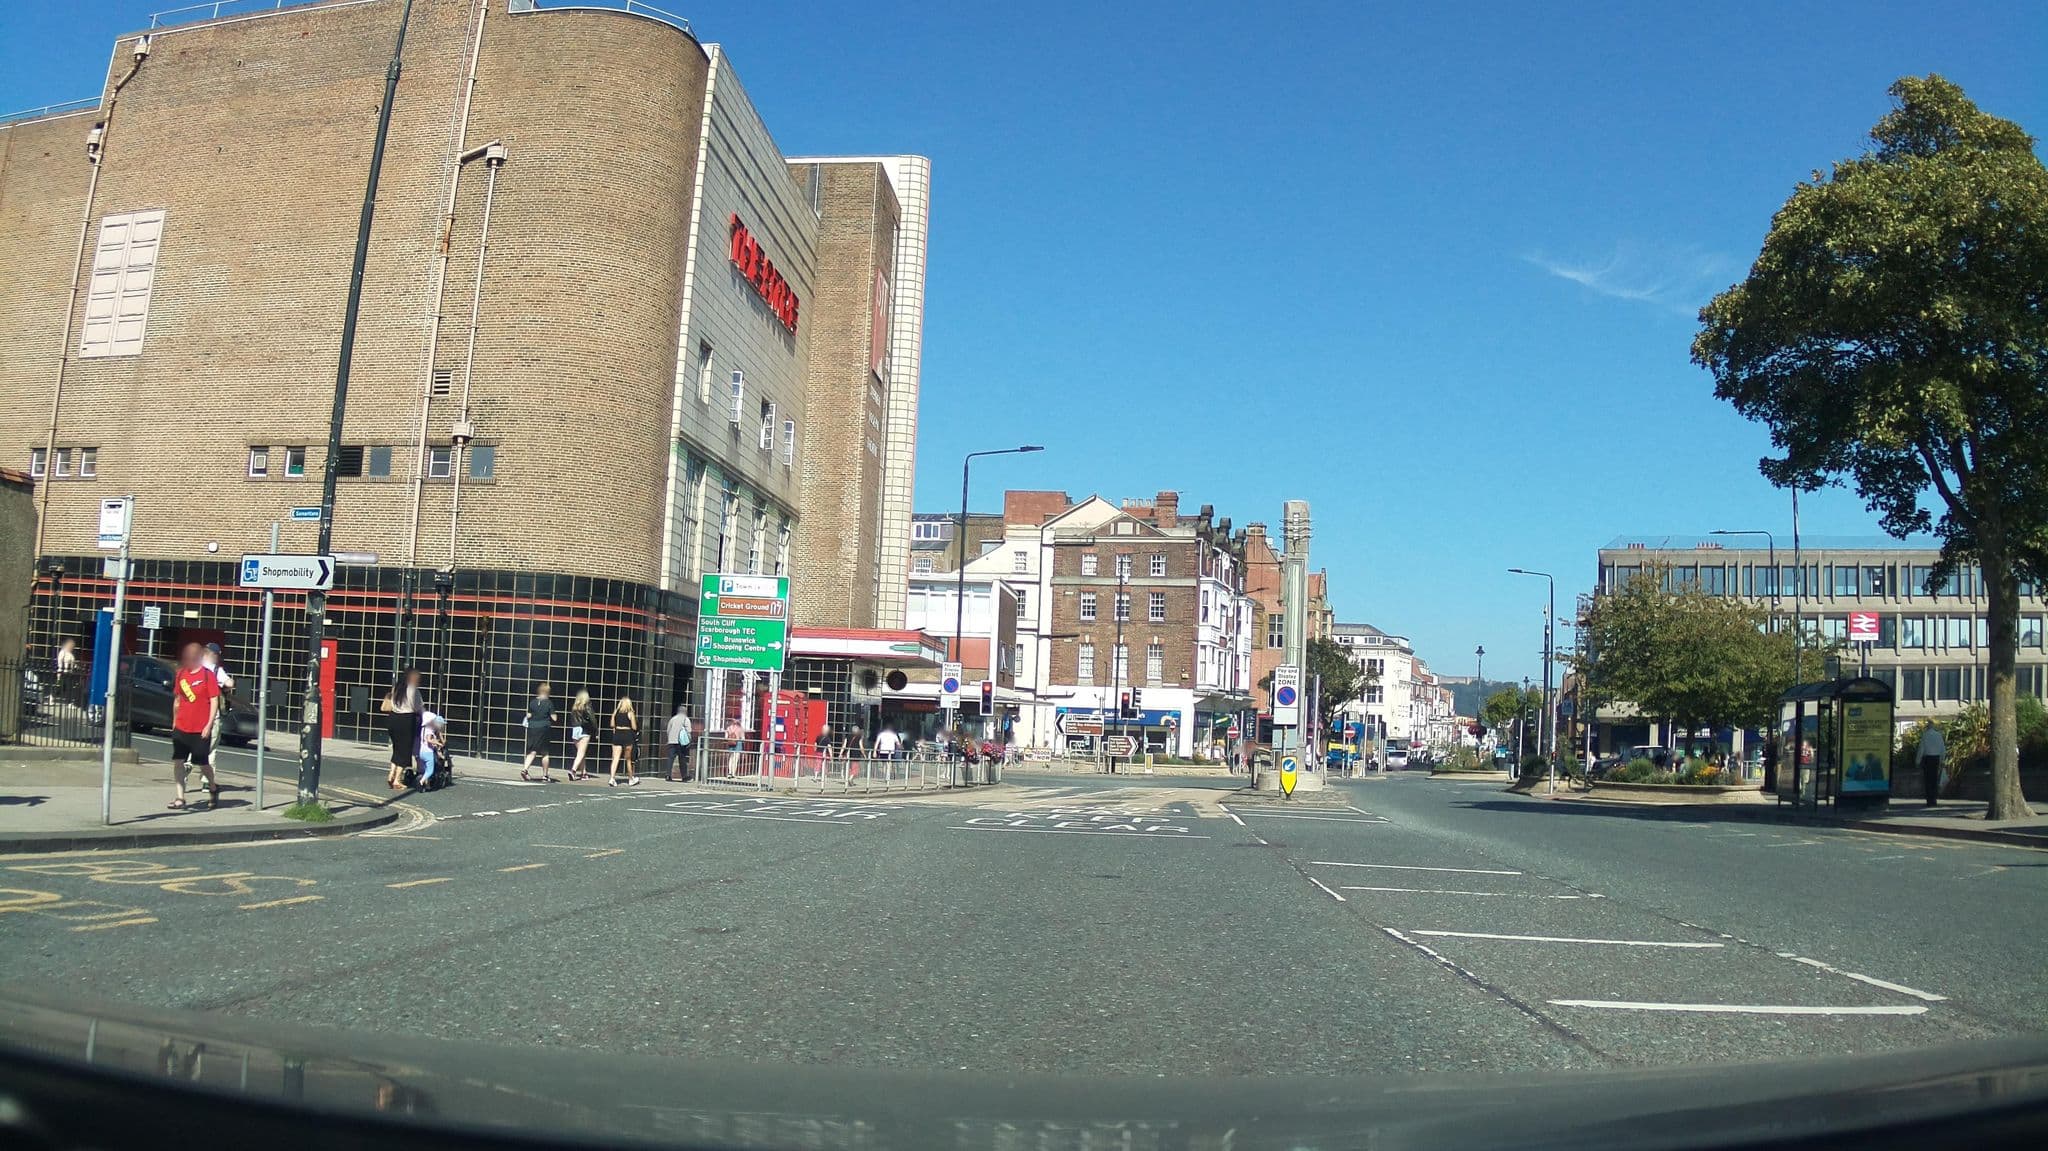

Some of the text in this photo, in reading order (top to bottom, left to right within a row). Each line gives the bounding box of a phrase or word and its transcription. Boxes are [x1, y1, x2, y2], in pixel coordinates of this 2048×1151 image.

[262, 566, 314, 579] Shopmobility
[720, 602, 769, 611] Cricket Ground
[721, 619, 736, 627] Cliff
[700, 626, 741, 635] Scarborough
[724, 636, 756, 644] Brunswick
[713, 643, 766, 652] Shopping Centre
[713, 655, 754, 665] Shopmobility
[664, 801, 888, 820] CLEAR
[1004, 812, 1170, 823] KEEP
[964, 817, 1190, 833] CLEAR
[4, 860, 317, 896] BUS
